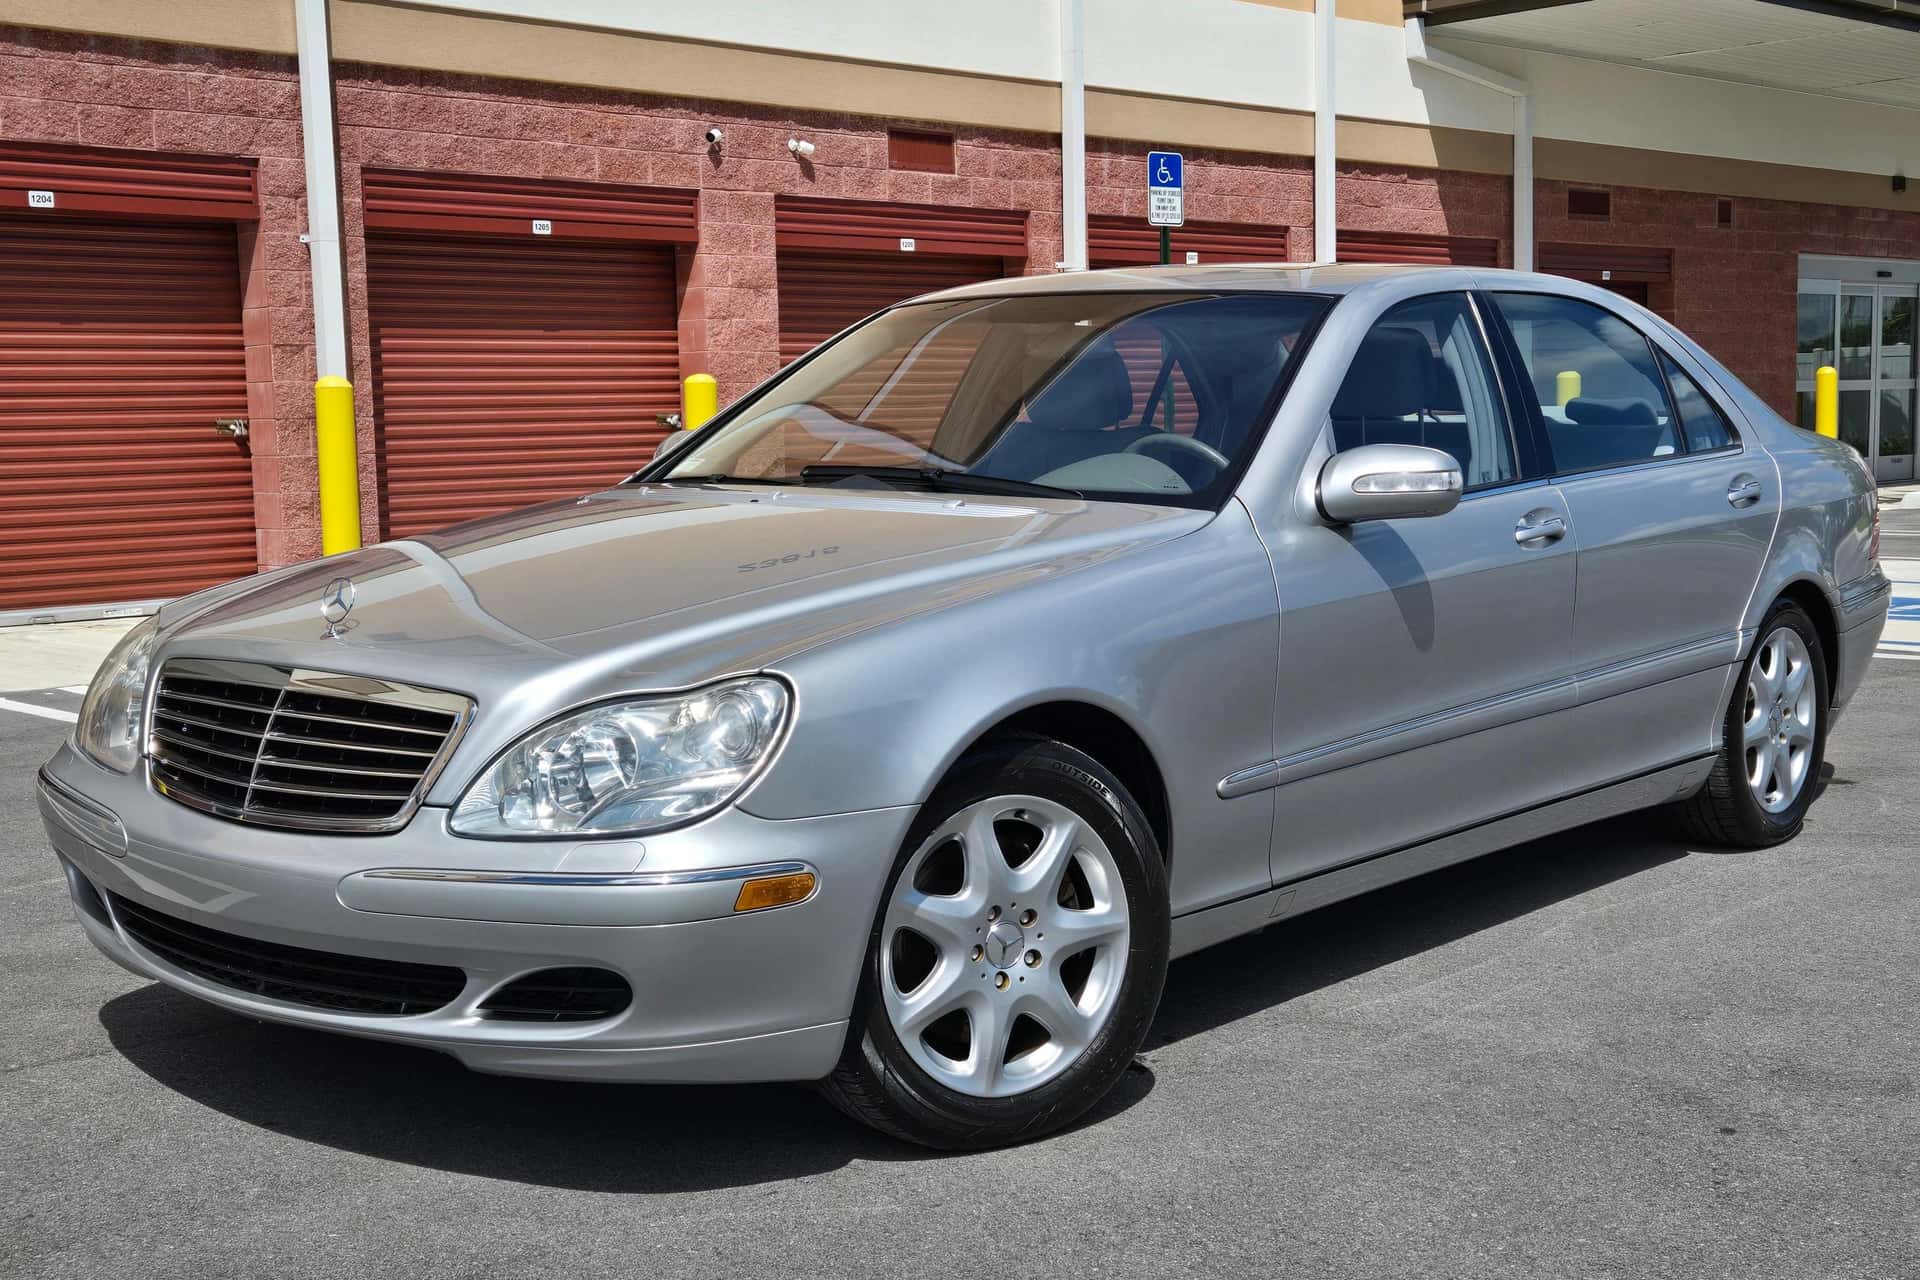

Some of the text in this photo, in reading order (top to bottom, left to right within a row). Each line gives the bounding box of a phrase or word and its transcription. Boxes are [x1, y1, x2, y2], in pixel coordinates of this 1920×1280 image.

[31, 194, 52, 204] 1204
[535, 223, 550, 231] 1205
[1052, 760, 1111, 798] OUTSIDE
